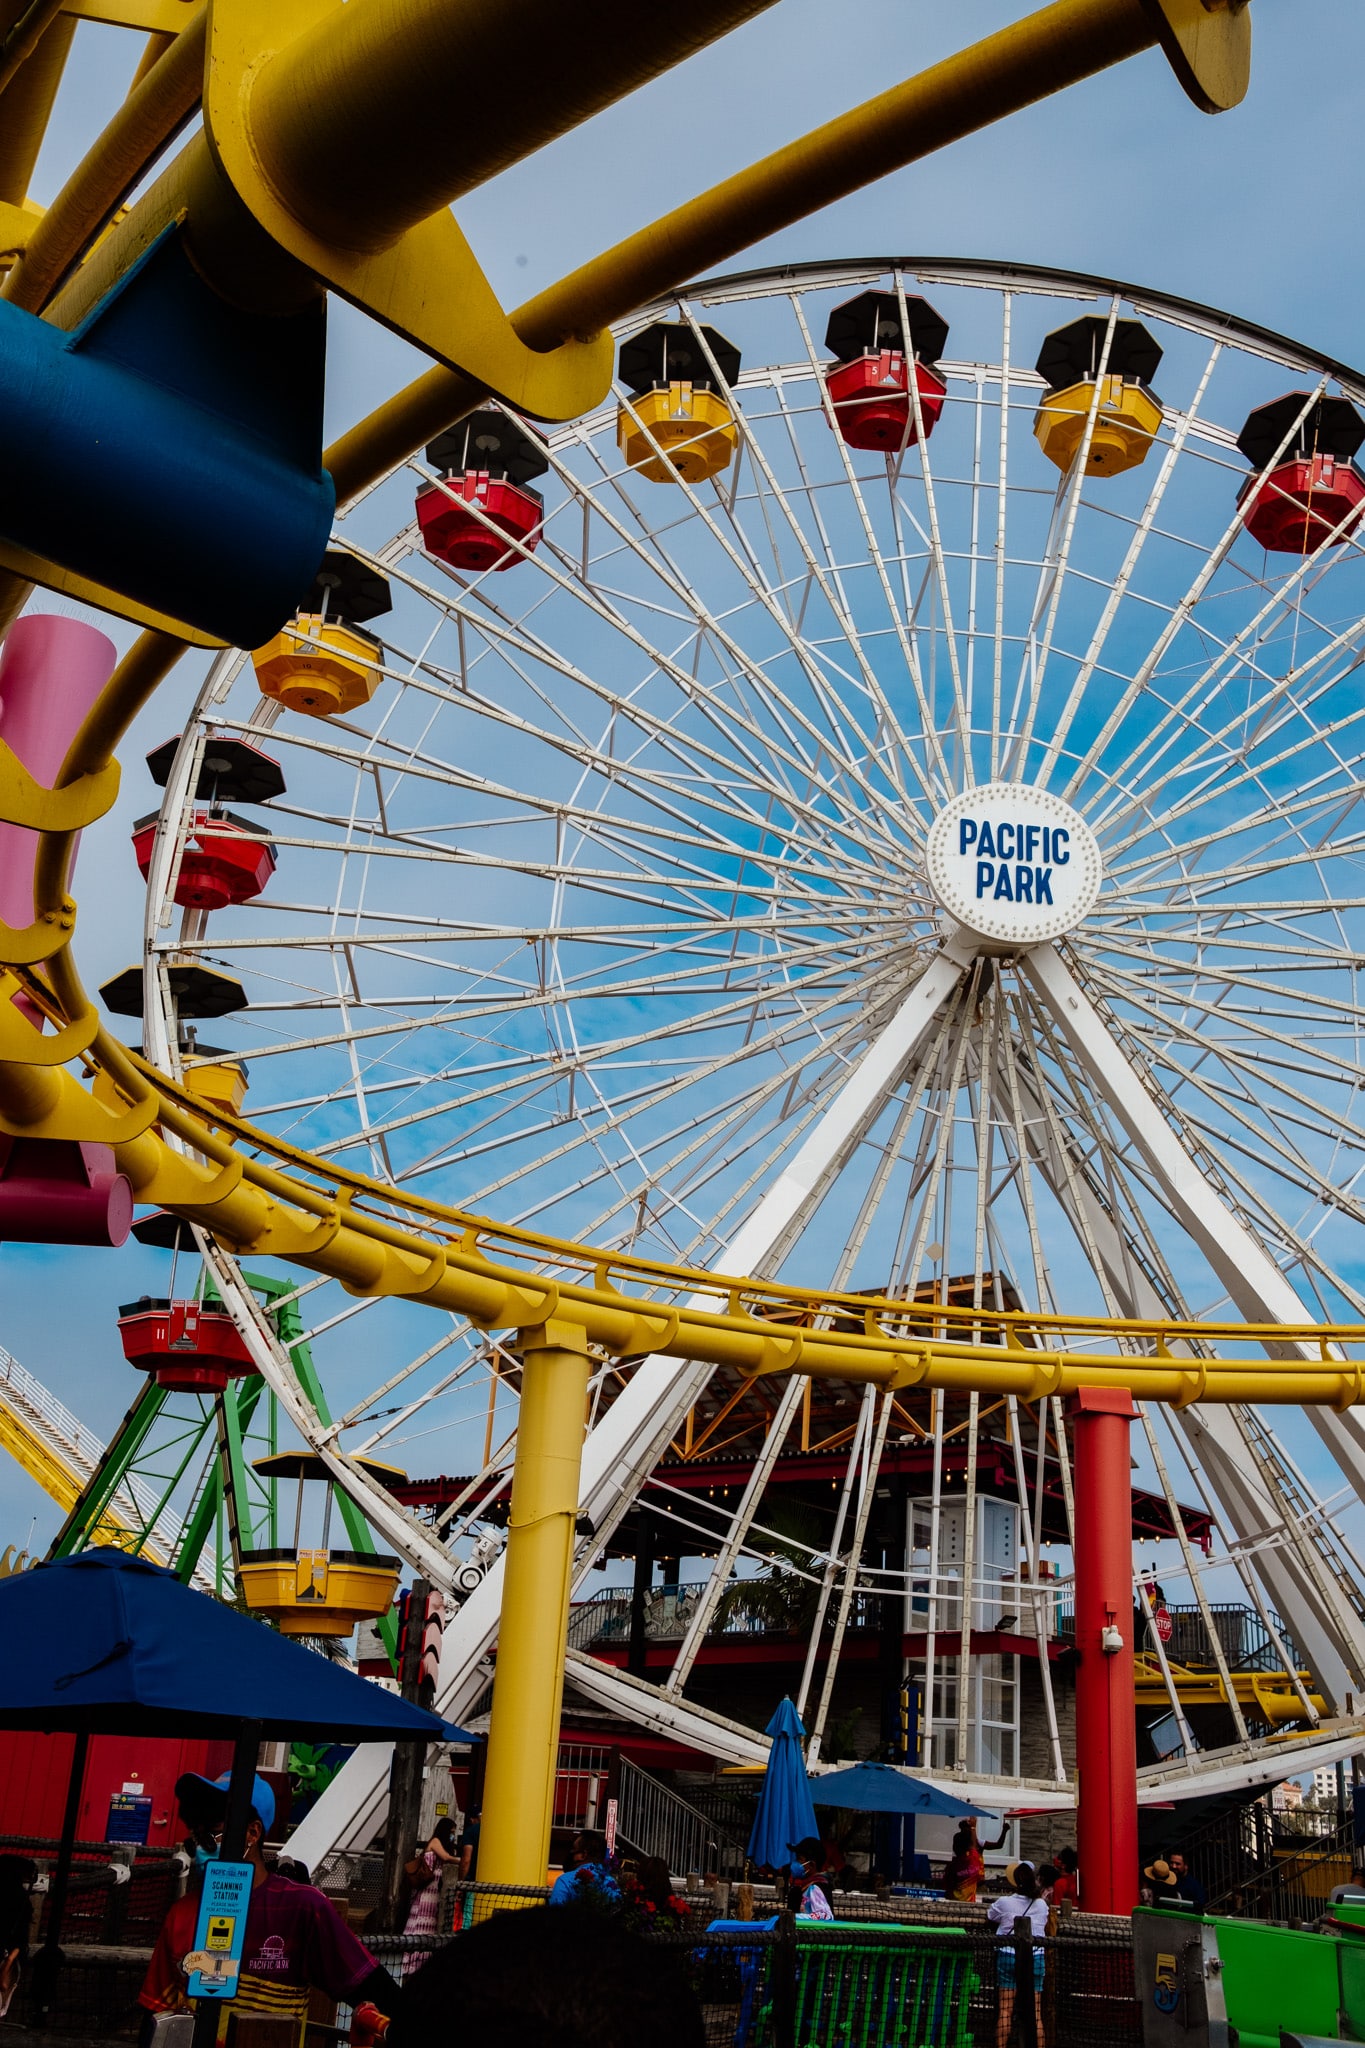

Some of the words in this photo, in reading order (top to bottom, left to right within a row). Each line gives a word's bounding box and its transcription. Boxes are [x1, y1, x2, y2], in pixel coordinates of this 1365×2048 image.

[871, 366, 878, 375] 5
[1304, 470, 1310, 479] 3
[959, 818, 1070, 865] PACIFIC
[976, 861, 1054, 905] PARK
[156, 1328, 165, 1340] 11
[282, 1579, 296, 1591] 12
[1156, 1618, 1171, 1630] STOP
[210, 1868, 227, 1876] PACIFIC
[212, 1881, 243, 1892] SCANNING
[213, 1891, 239, 1901] STATION
[248, 1959, 274, 1970] PACIFIC
[1153, 1951, 1179, 2015] 5
